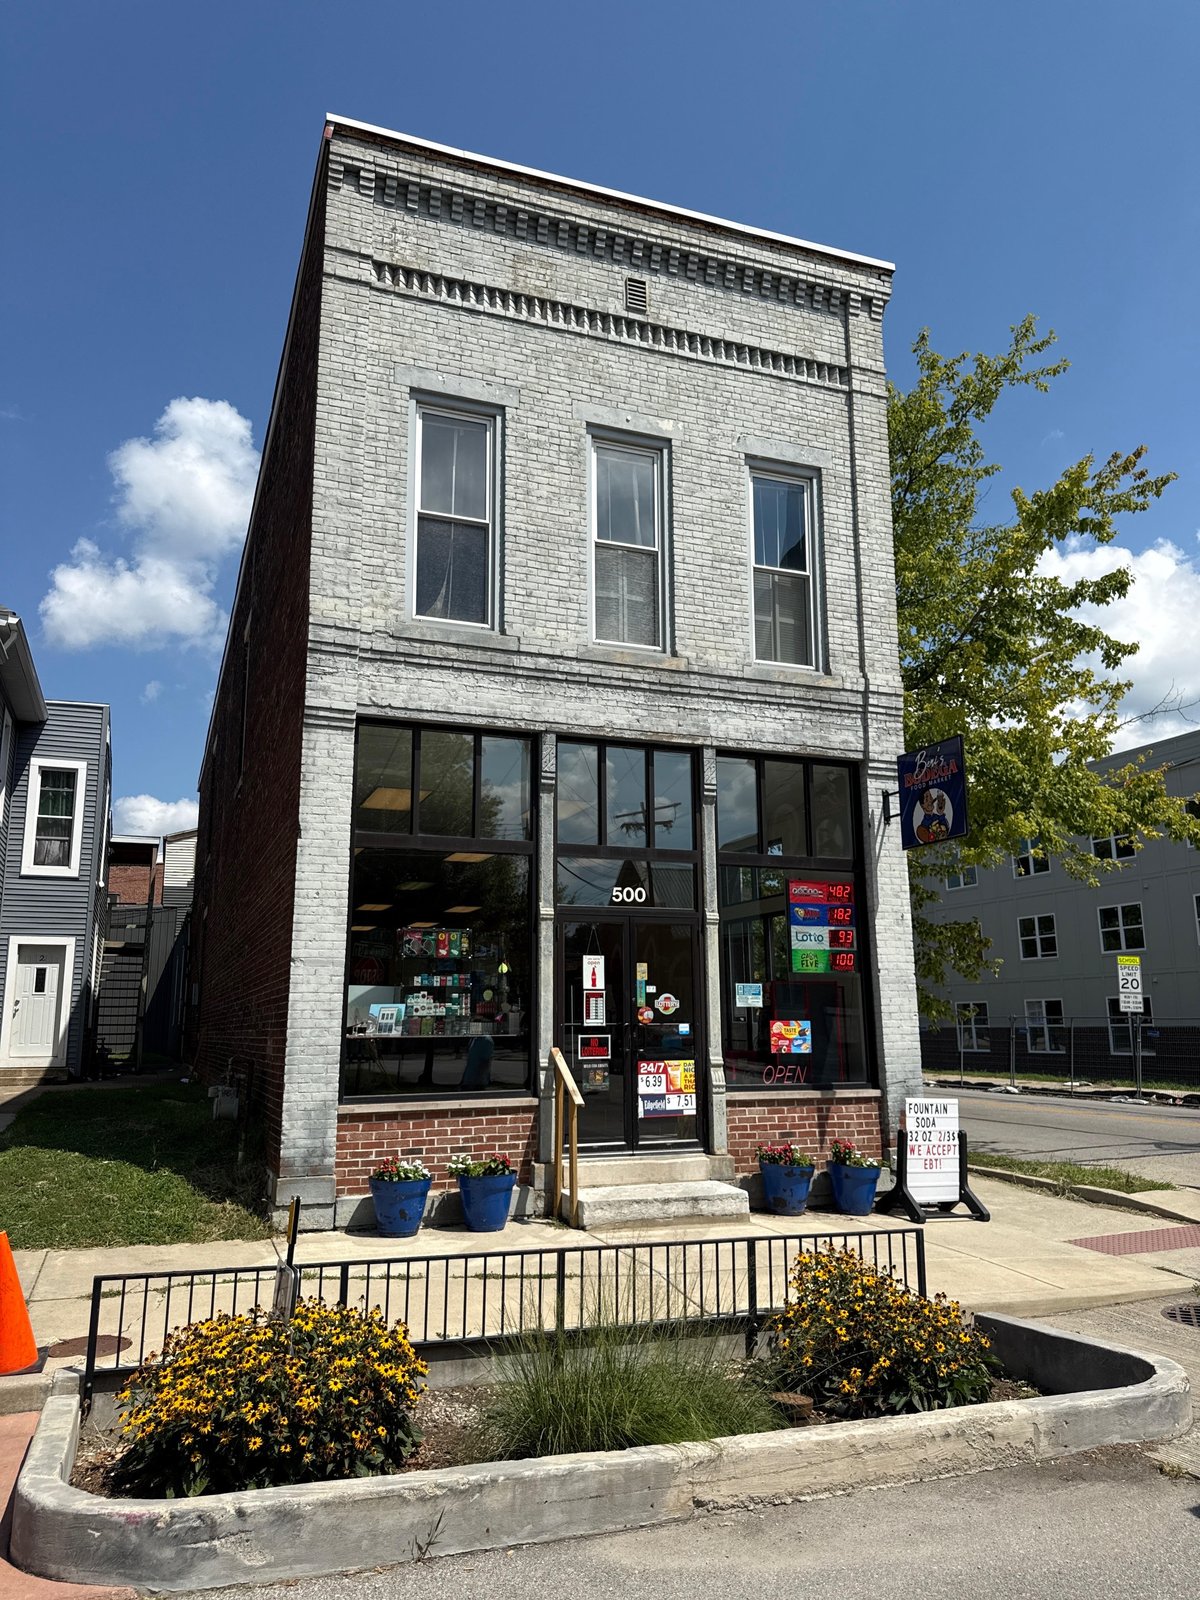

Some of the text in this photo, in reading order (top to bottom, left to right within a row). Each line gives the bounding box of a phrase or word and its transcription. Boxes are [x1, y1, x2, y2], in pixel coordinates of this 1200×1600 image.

[904, 759, 959, 788] BODEGA
[910, 775, 952, 791] FOOD MARKET
[612, 886, 647, 903] 500
[829, 885, 851, 898] 482
[834, 908, 852, 920] 182
[795, 931, 824, 943] Lotto
[839, 931, 853, 943] 93
[39, 954, 46, 962] 2
[801, 960, 819, 968] FIVE
[836, 953, 854, 966] 100
[1120, 978, 1140, 990] 20
[656, 1000, 679, 1008] LOTTERY
[590, 1038, 599, 1047] NO
[582, 1046, 608, 1056] LOITERING
[640, 1062, 665, 1074] 24/7
[762, 1065, 807, 1085] OPEN
[644, 1099, 666, 1111] Edgefield
[676, 1095, 693, 1107] 7.51
[908, 1103, 948, 1115] FOUNTAIN
[915, 1117, 936, 1128] SODA
[909, 1131, 956, 1142] 32 OZ 2/3$
[909, 1145, 957, 1156] WE ACCEPT
[923, 1158, 943, 1170] EBT!
